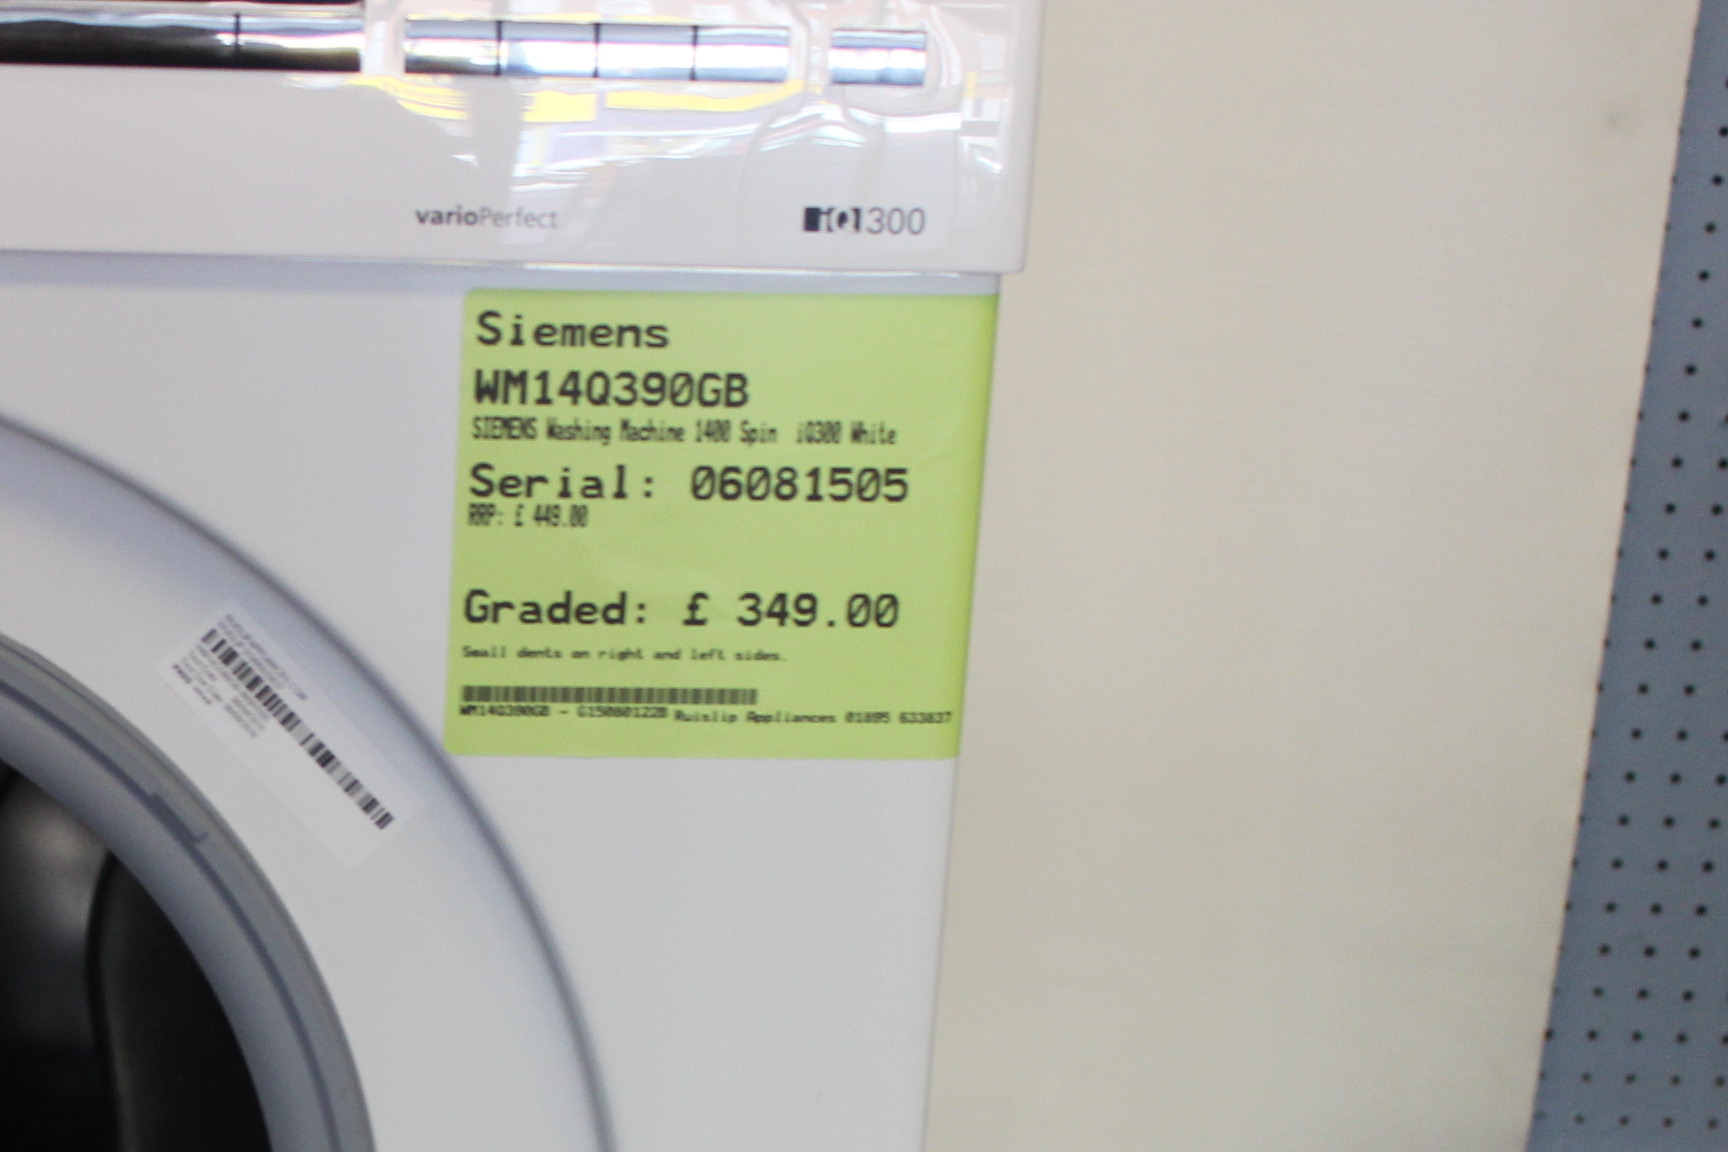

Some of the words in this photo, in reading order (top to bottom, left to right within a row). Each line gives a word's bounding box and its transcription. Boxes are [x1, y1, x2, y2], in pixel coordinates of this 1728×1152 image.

[415, 204, 558, 230] varioPerfect
[476, 310, 670, 348] Siemens
[474, 369, 749, 407] WM14Q390GB
[472, 417, 538, 440] SIEMENS
[546, 418, 611, 445] Washing
[619, 419, 685, 443] Machine
[695, 420, 731, 442] 1400
[740, 421, 778, 447] Spin
[796, 421, 842, 445] iQ300
[850, 421, 898, 446] White
[469, 463, 655, 499] Serial:
[691, 466, 910, 502] 06081505
[468, 504, 504, 527] RRP:
[533, 505, 589, 528] 449.00
[463, 589, 647, 626] Graded:
[682, 592, 708, 626] £
[737, 592, 900, 628] 349.00
[461, 646, 507, 658] Small
[517, 646, 562, 659] dents
[570, 649, 590, 660] on
[597, 648, 643, 661] right
[653, 649, 681, 660] and
[690, 649, 726, 661] left
[734, 650, 787, 661] sides.
[674, 710, 738, 723] Ruislip
[745, 711, 836, 724] Appliances
